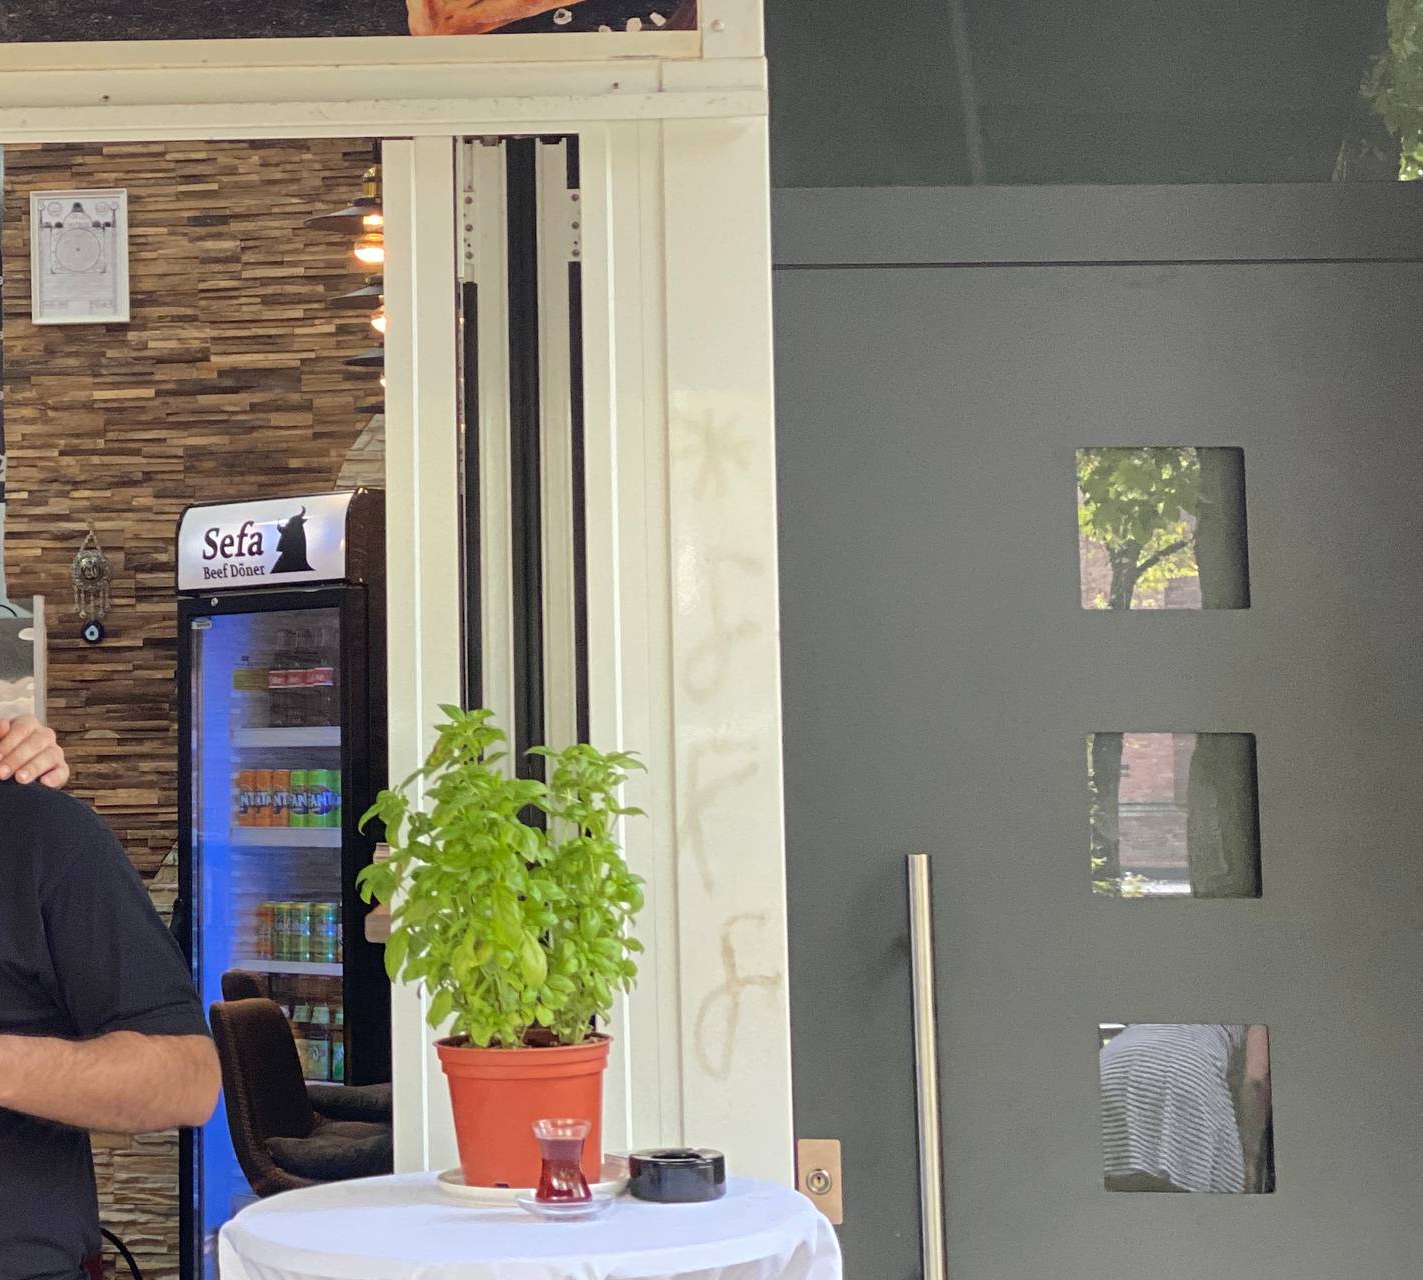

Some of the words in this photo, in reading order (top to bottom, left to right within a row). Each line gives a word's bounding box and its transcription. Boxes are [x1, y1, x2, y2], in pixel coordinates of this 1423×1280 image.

[203, 520, 264, 560] Sefa
[203, 564, 229, 579] Beef
[230, 563, 265, 578] Döner
